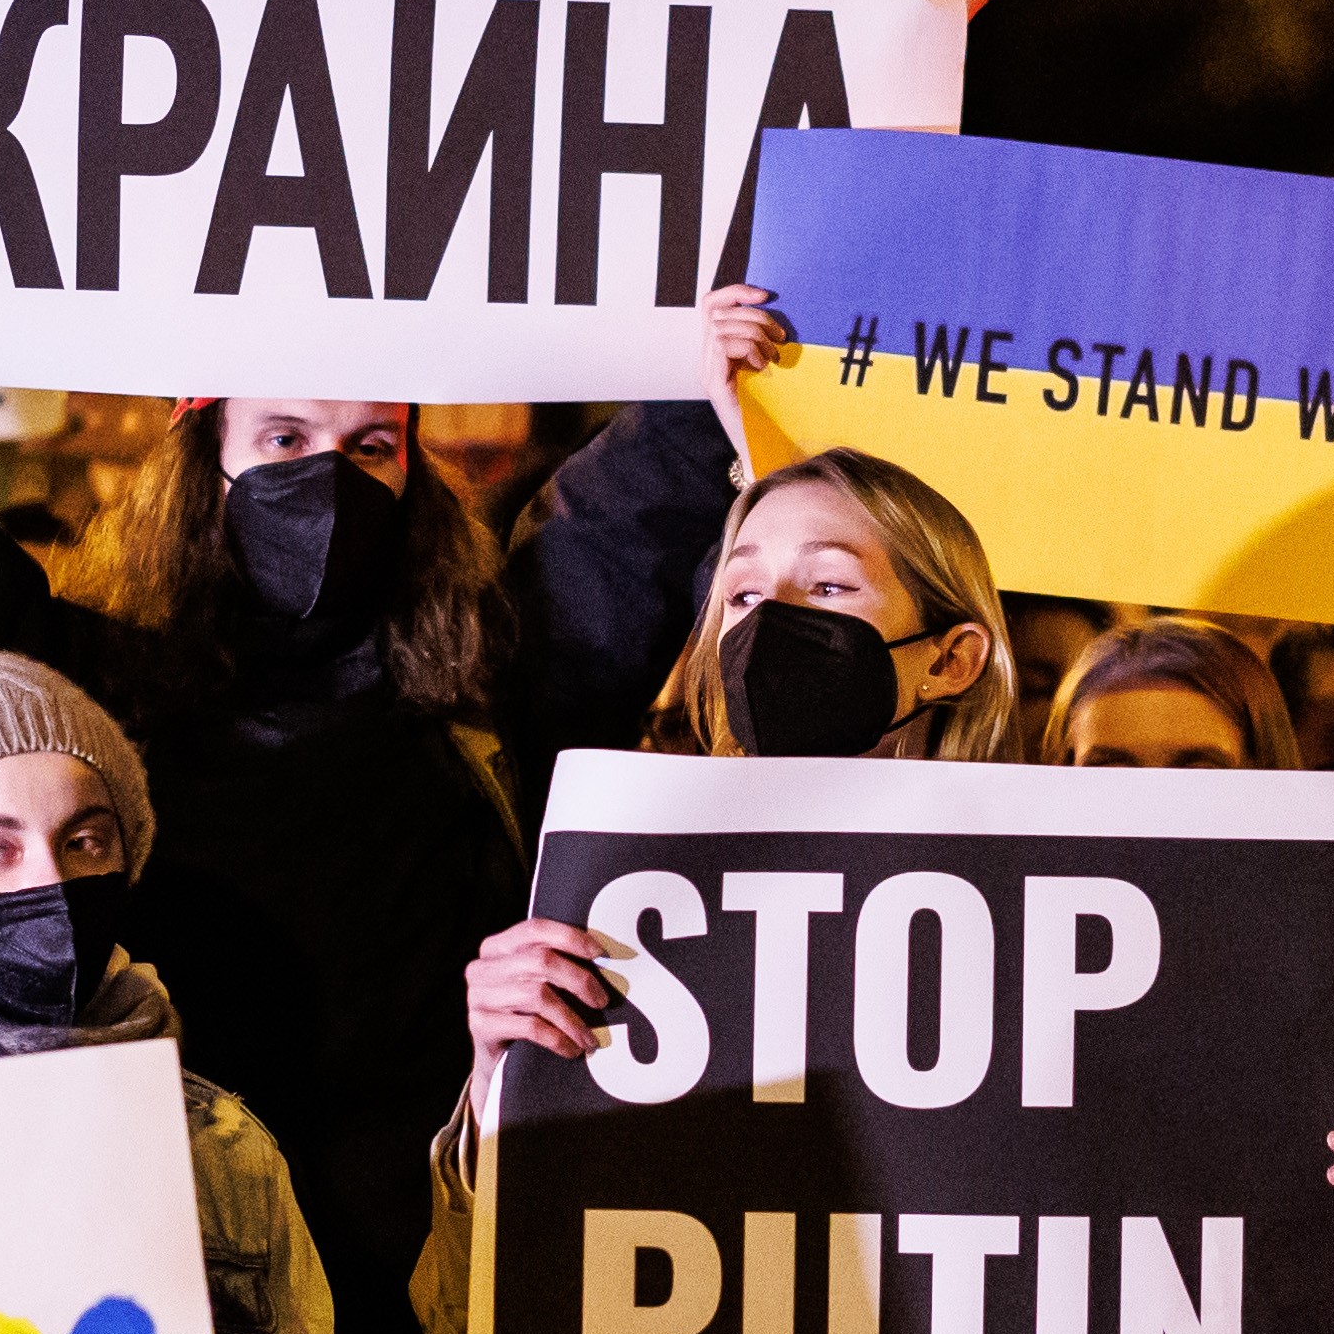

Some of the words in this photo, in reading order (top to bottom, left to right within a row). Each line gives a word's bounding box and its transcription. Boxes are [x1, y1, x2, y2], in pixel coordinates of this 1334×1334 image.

[913, 320, 1014, 405] WE
[1041, 338, 1260, 432] STAND
[583, 870, 1161, 1108] STOP
